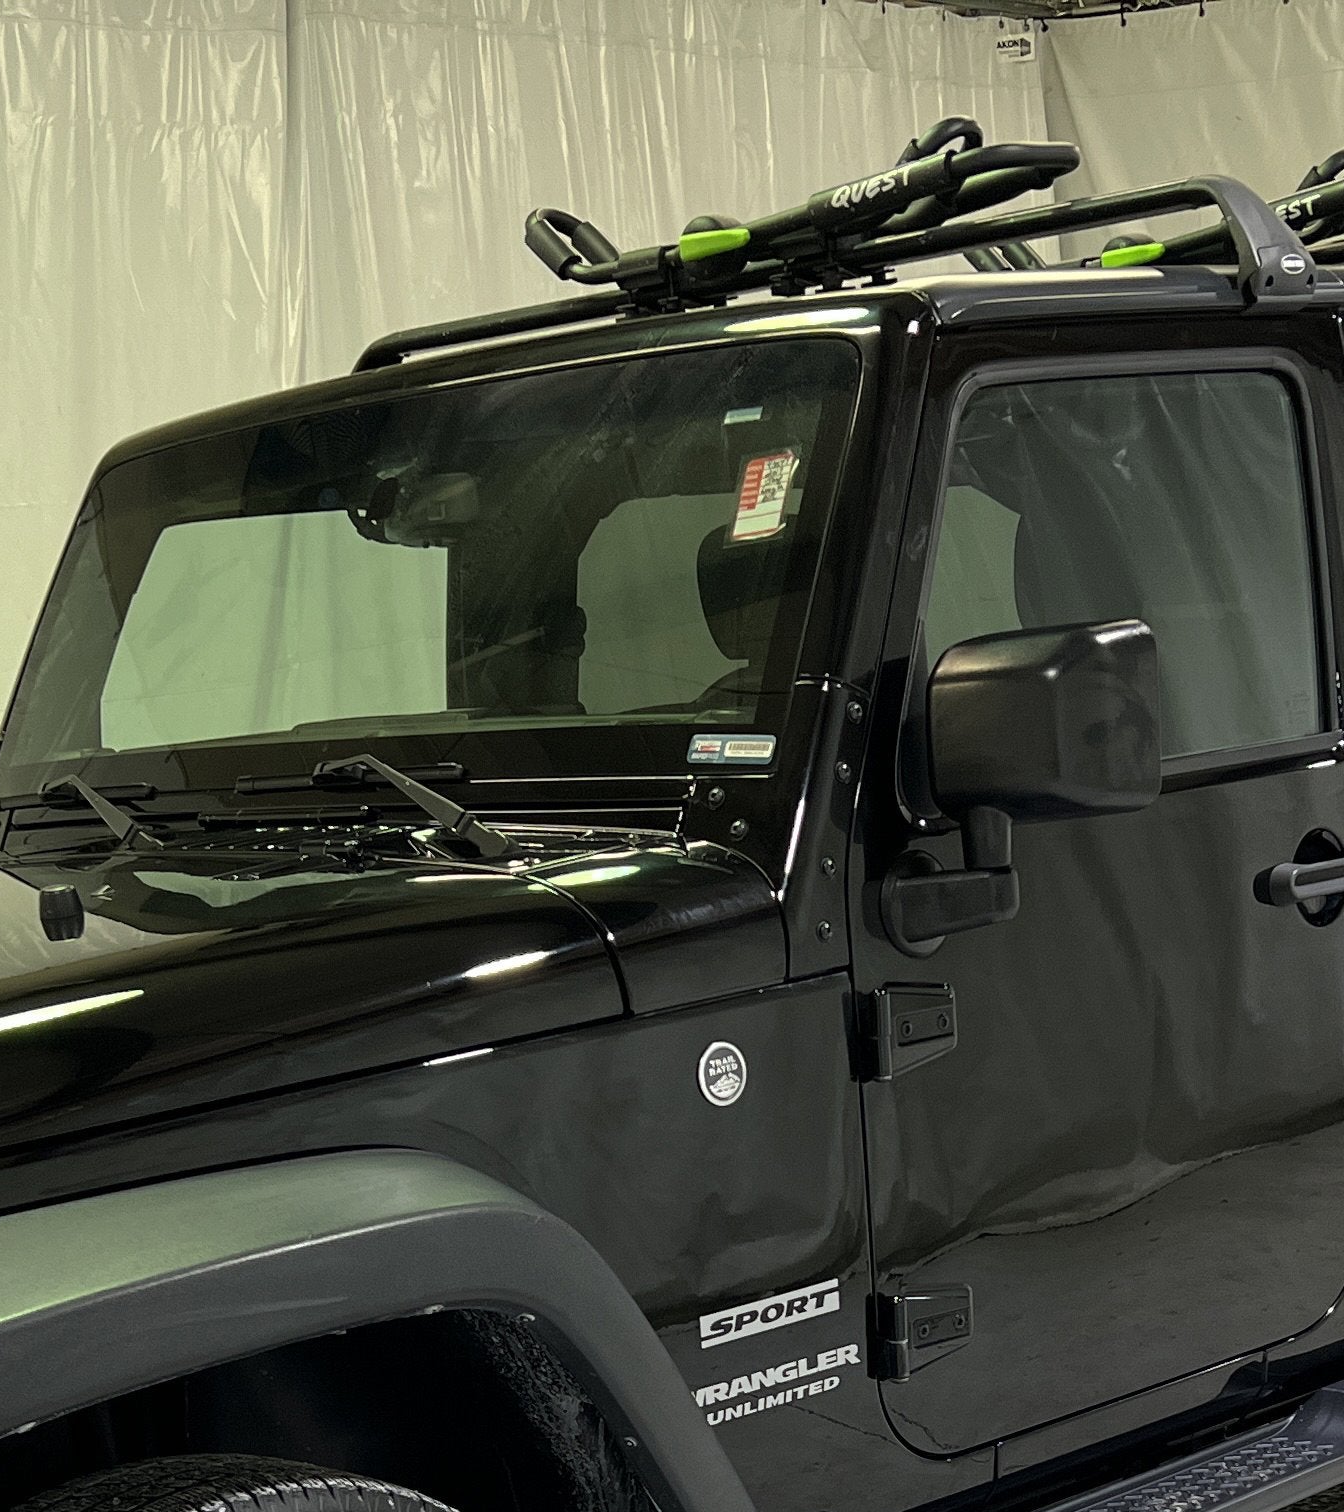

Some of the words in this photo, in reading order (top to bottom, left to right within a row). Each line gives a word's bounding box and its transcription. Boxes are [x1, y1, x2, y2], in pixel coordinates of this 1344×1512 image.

[831, 168, 912, 208] QUEST
[1275, 194, 1321, 221] EST
[709, 1055, 736, 1068] TRAIL
[709, 1063, 738, 1077] RATED
[702, 1287, 840, 1341] SPORT
[707, 1376, 841, 1426] UNLIMITED
